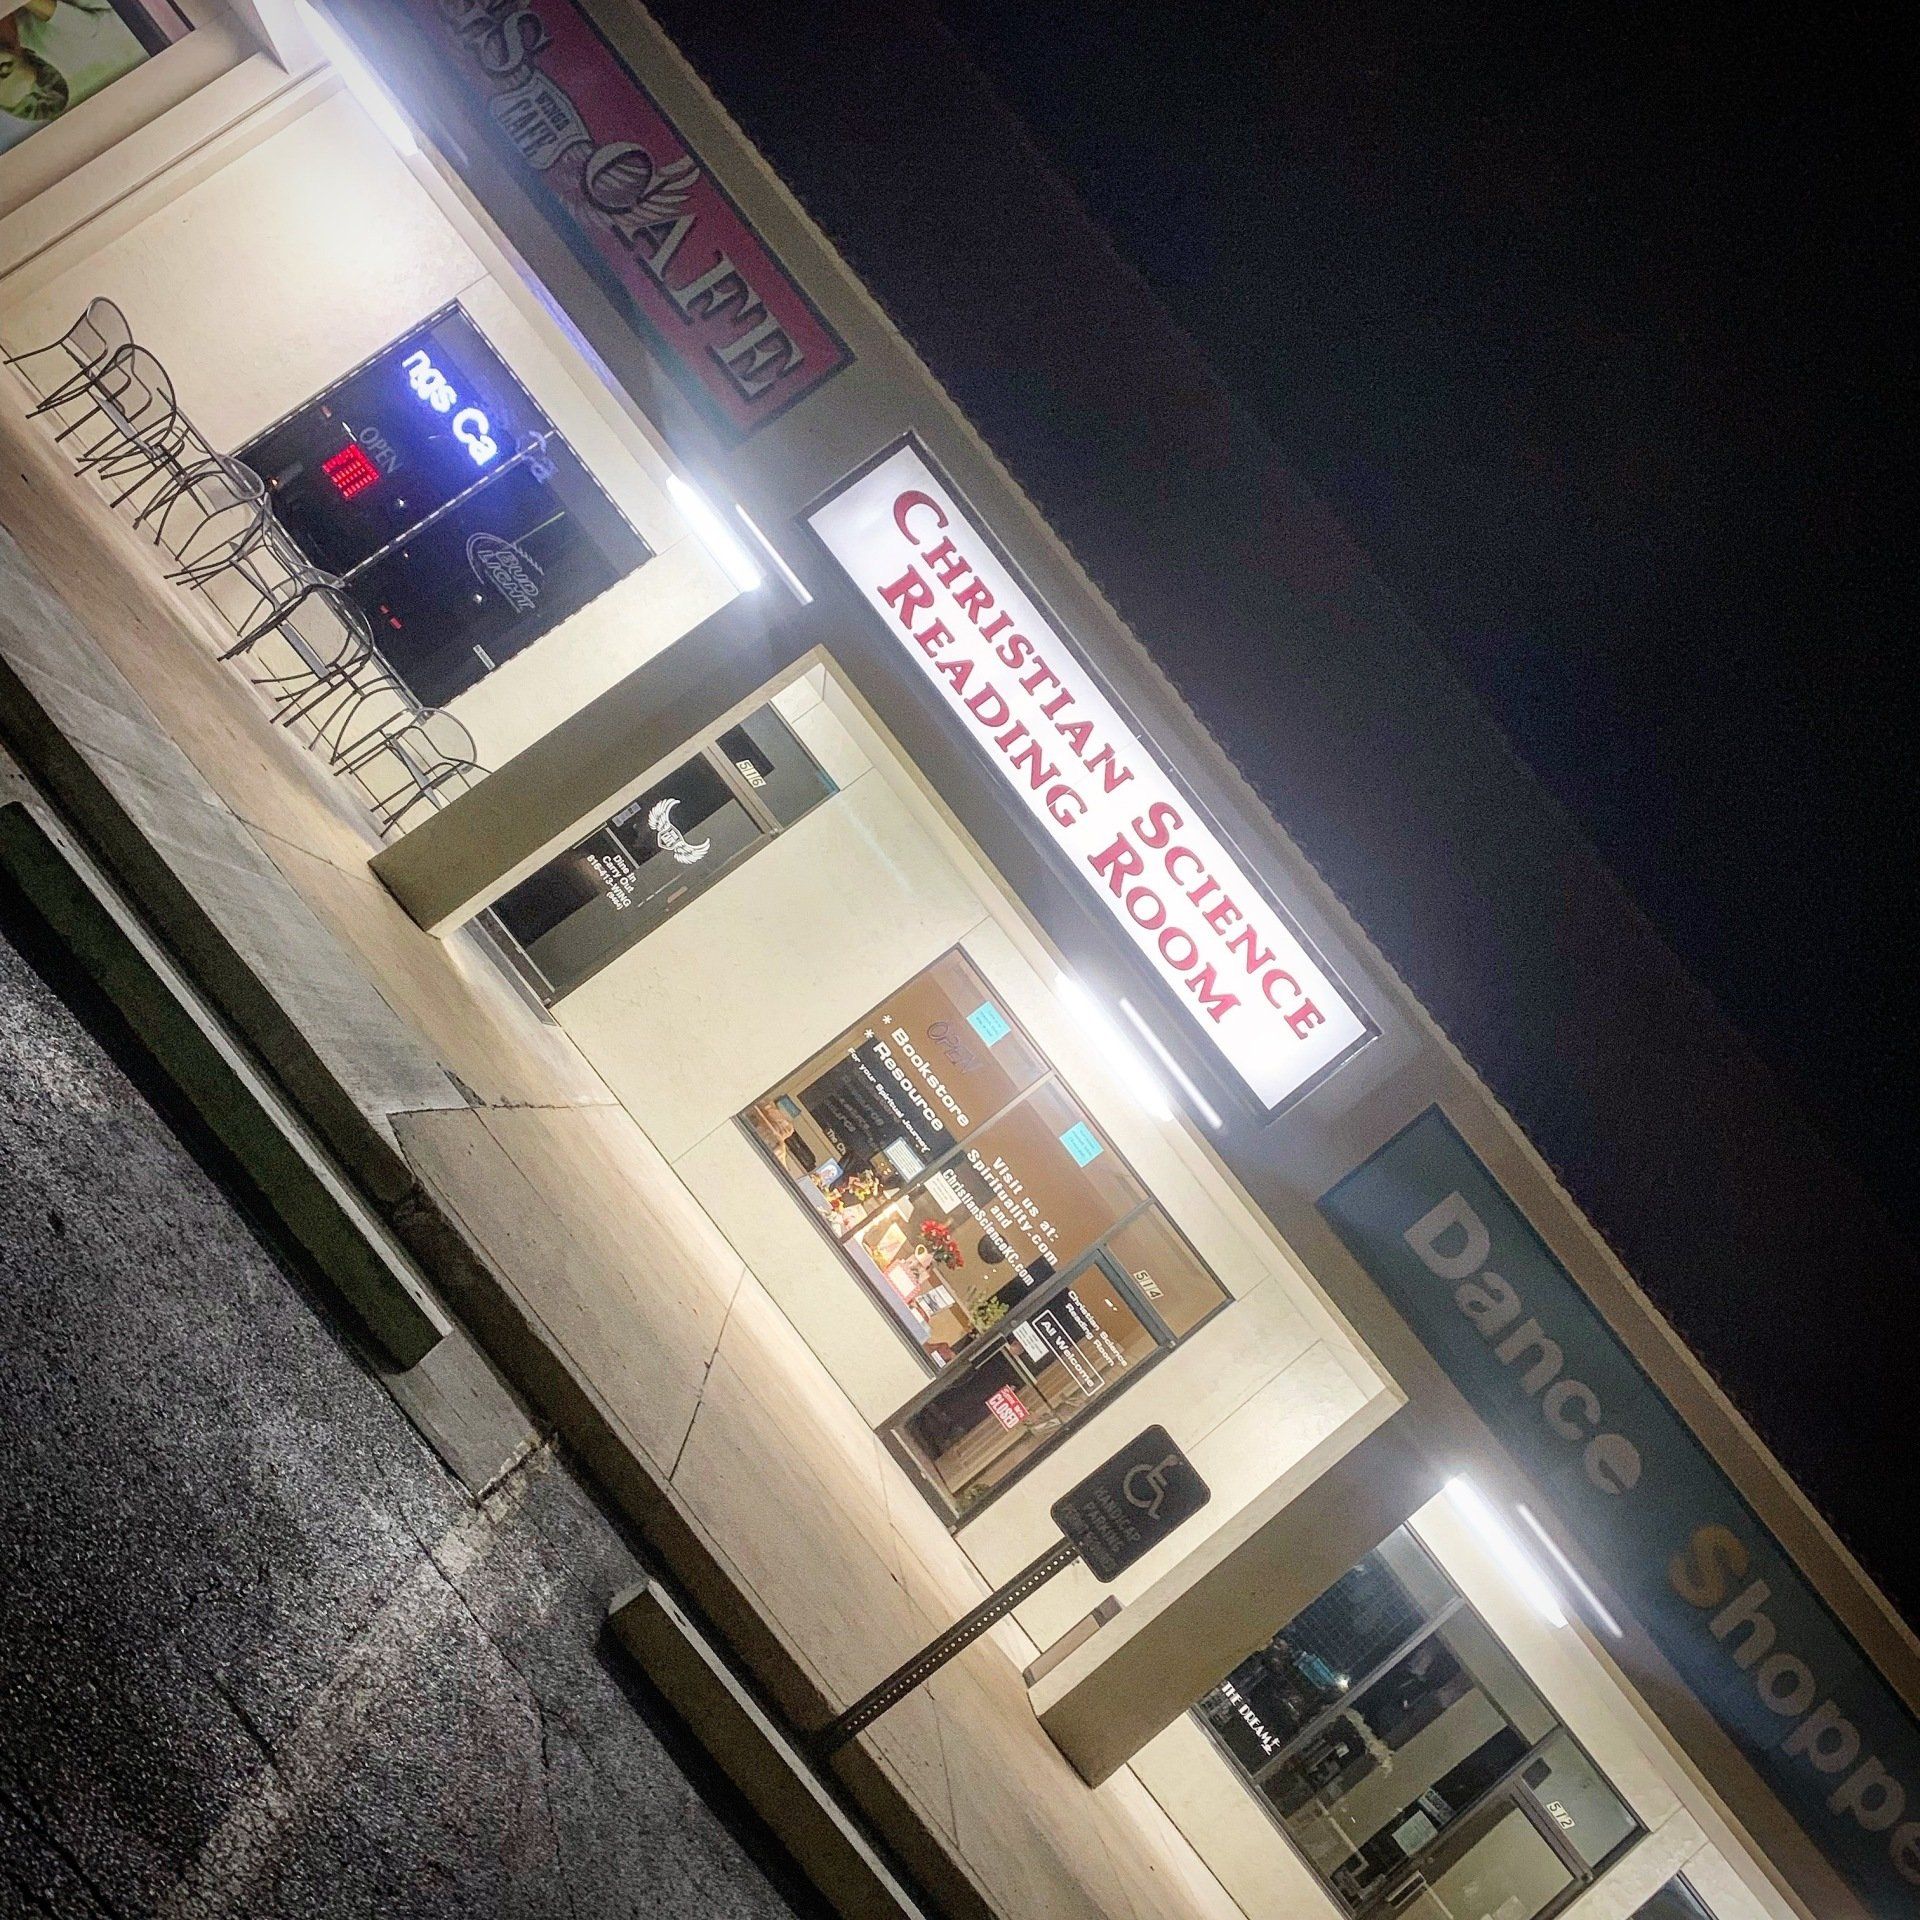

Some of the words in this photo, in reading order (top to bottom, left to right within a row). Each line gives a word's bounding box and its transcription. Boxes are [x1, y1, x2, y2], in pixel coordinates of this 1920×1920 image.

[494, 93, 559, 162] CAFE
[579, 138, 807, 402] CAFE
[356, 423, 403, 475] OPEN
[476, 550, 536, 611] LIGHT
[493, 544, 541, 600] BUD
[738, 761, 763, 787] 516
[600, 854, 622, 879] Carry
[617, 875, 635, 894] Out
[612, 854, 631, 875] Dine
[626, 871, 638, 883] In
[889, 1025, 972, 1129] Bookstore
[923, 1017, 984, 1079] OPEN
[846, 1046, 862, 1064] For
[857, 1062, 877, 1085] your
[873, 1082, 905, 1120] Spiritual
[871, 1040, 947, 1133] Resource
[941, 1166, 1036, 1287] ChristianScienceKC.com
[964, 1148, 1059, 1266] Spirituality.com
[989, 1203, 1012, 1229] and
[990, 1156, 1024, 1195] Visit
[1020, 1196, 1041, 1218] us
[1037, 1217, 1061, 1243] at:
[1135, 1271, 1161, 1299] 514
[1040, 1318, 1057, 1337] All
[1053, 1334, 1096, 1388] Welcome
[1063, 1302, 1095, 1340] Reading
[1091, 1338, 1116, 1367] Room
[1066, 1288, 1101, 1332] Christian
[1098, 1329, 1129, 1368] Science
[1402, 1192, 1643, 1497] Dance
[987, 1392, 1020, 1429] CLOSED
[1080, 1499, 1126, 1554] PARKING
[1091, 1484, 1142, 1545] HANDICAP
[1219, 1680, 1243, 1706] THE
[1237, 1702, 1273, 1745] DREAM
[1548, 1802, 1573, 1828] 512
